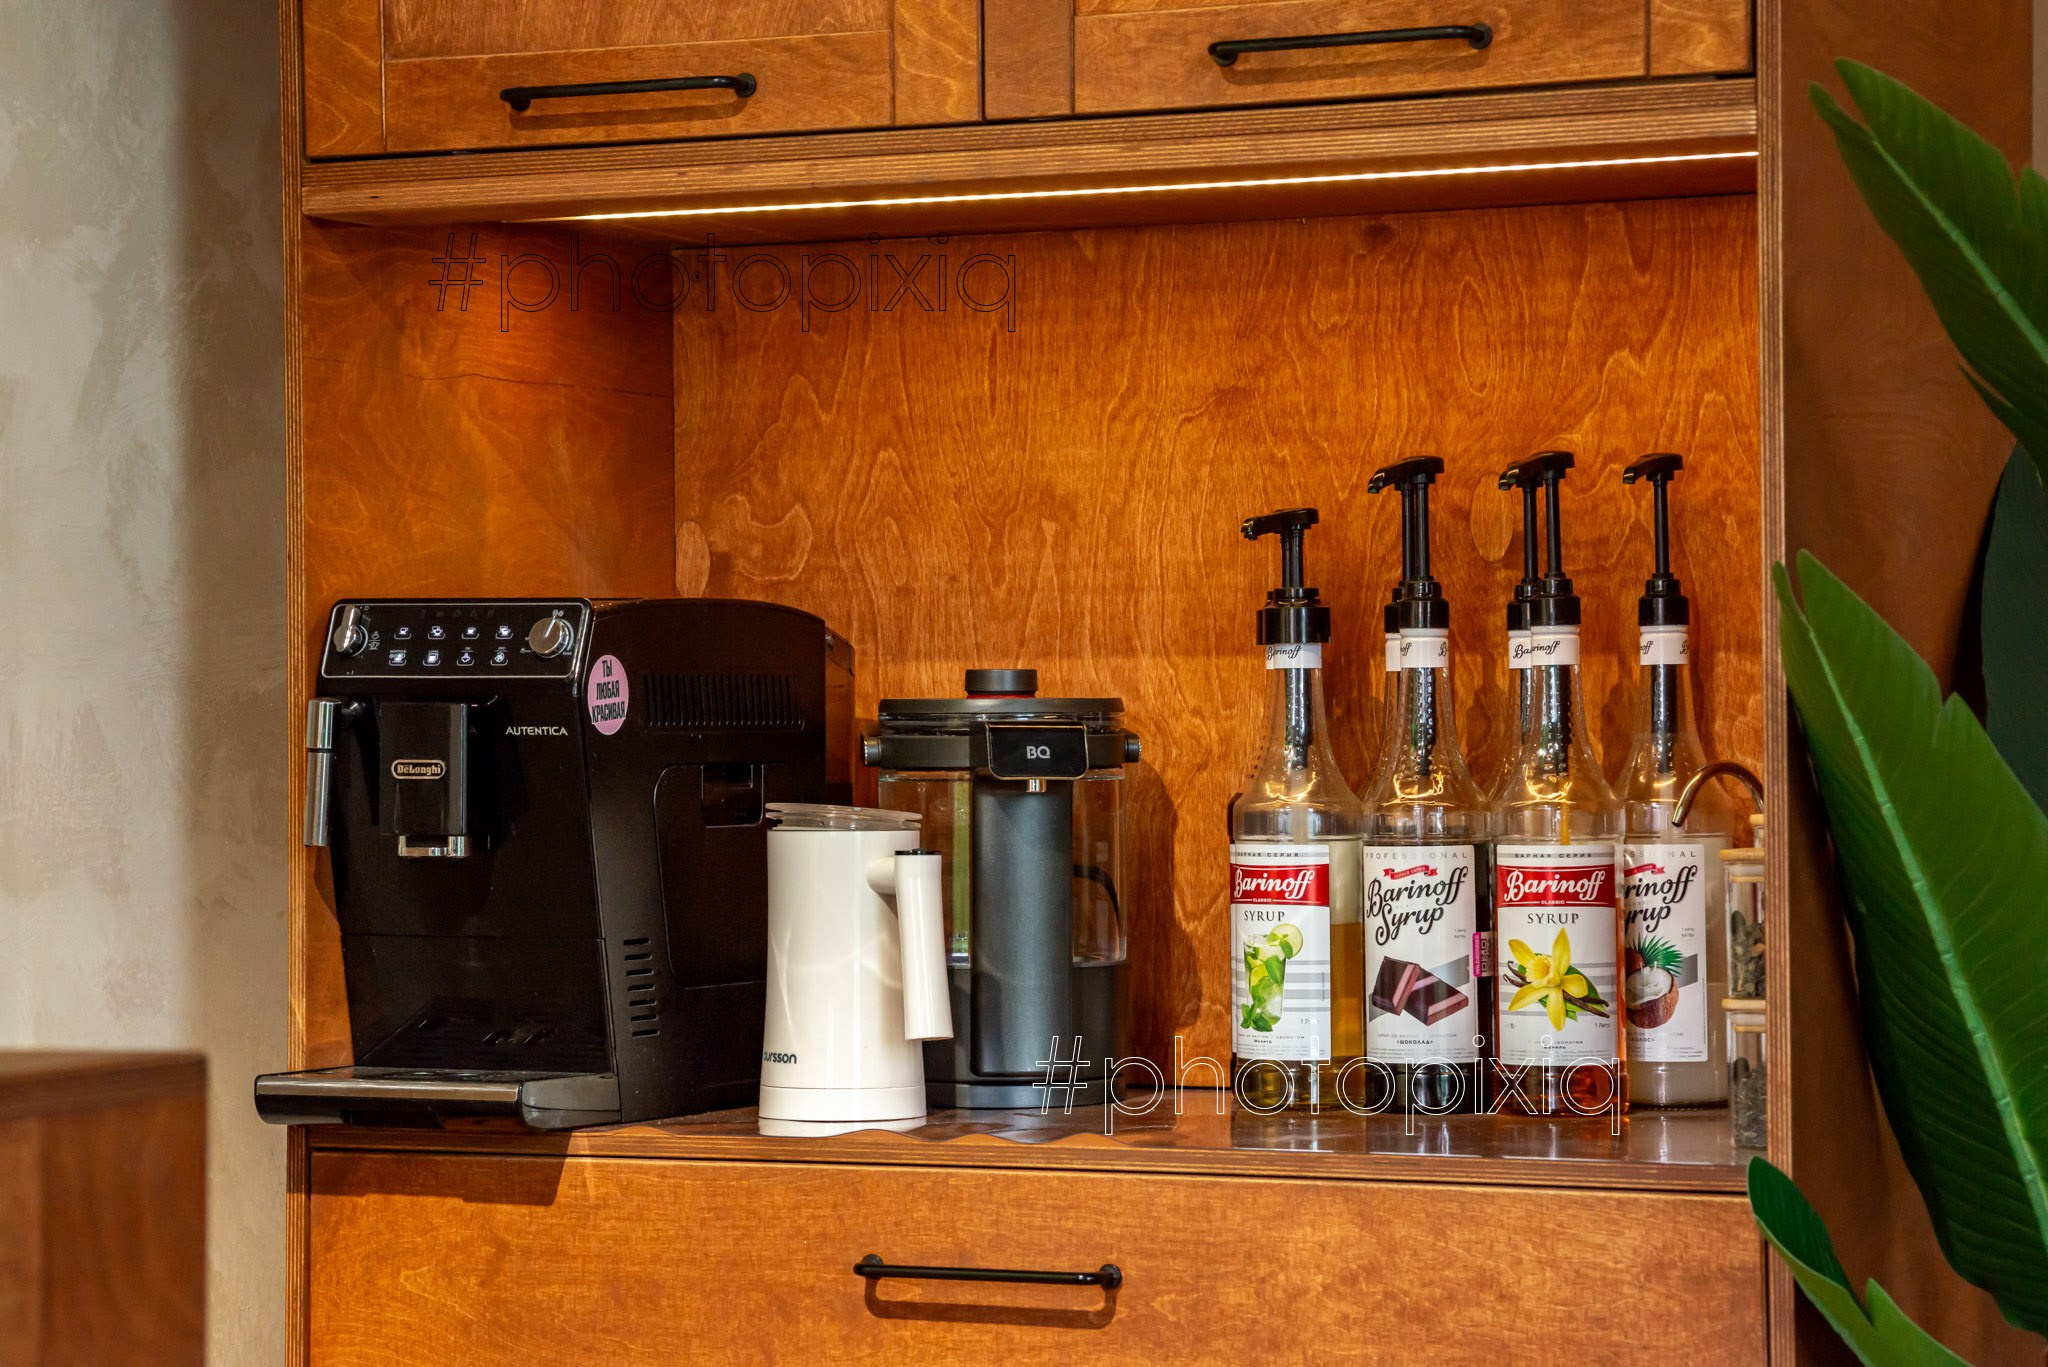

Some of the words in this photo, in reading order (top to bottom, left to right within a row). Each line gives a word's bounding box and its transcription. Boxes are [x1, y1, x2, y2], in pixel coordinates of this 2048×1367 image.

[602, 659, 612, 677] ТЫ
[597, 680, 620, 700] ЛЮБАЯ
[592, 701, 625, 723] КРАСИВАЯ
[505, 726, 568, 736] AUTENTICA
[1027, 745, 1050, 759] BQ
[1234, 868, 1315, 899] Barinoff
[1367, 866, 1469, 918] Barinoff
[1504, 869, 1606, 902] Barinoff
[1624, 865, 1698, 904] rinoff
[1244, 911, 1285, 921] SYRUP
[1375, 903, 1444, 946] Syrup
[1527, 913, 1579, 924] SYRUP
